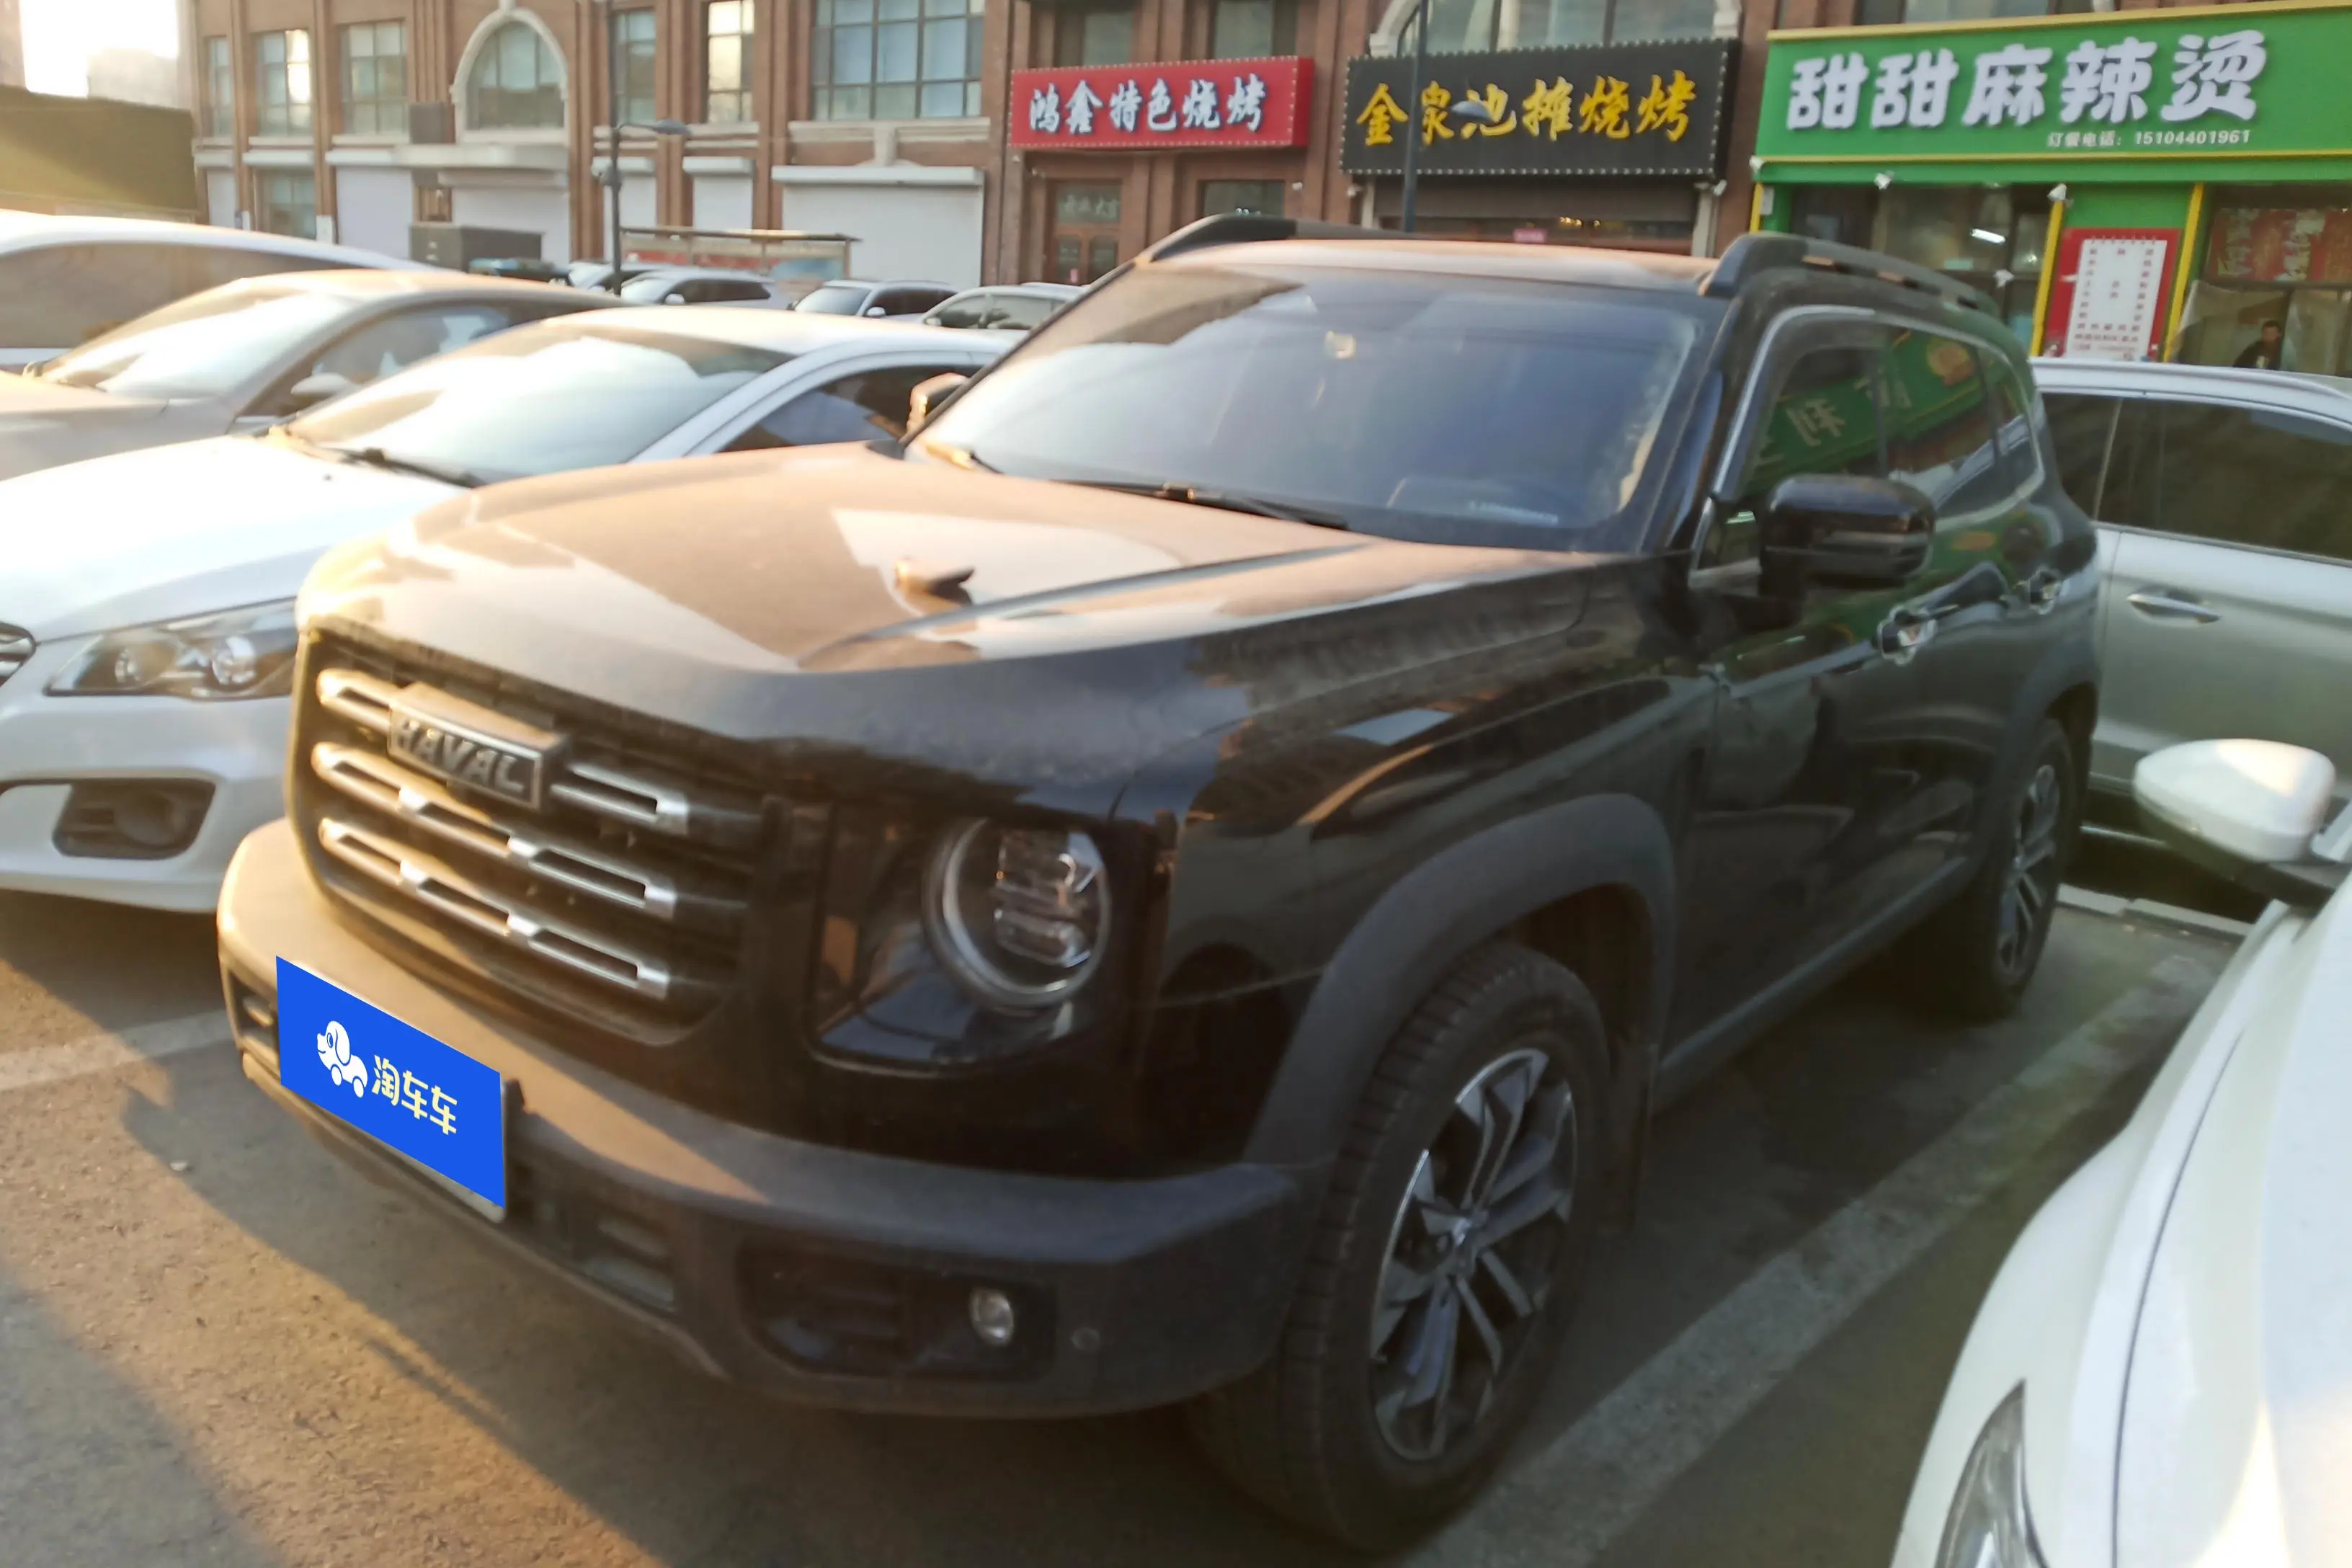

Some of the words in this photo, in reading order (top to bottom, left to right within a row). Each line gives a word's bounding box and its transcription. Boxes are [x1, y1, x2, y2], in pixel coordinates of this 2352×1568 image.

[1029, 73, 1266, 135] 鸿鑫特色烧烤
[1786, 30, 2268, 130] 甜甜麻辣烫
[2134, 129, 2251, 146] 15104401961
[398, 719, 525, 793] HAVAL
